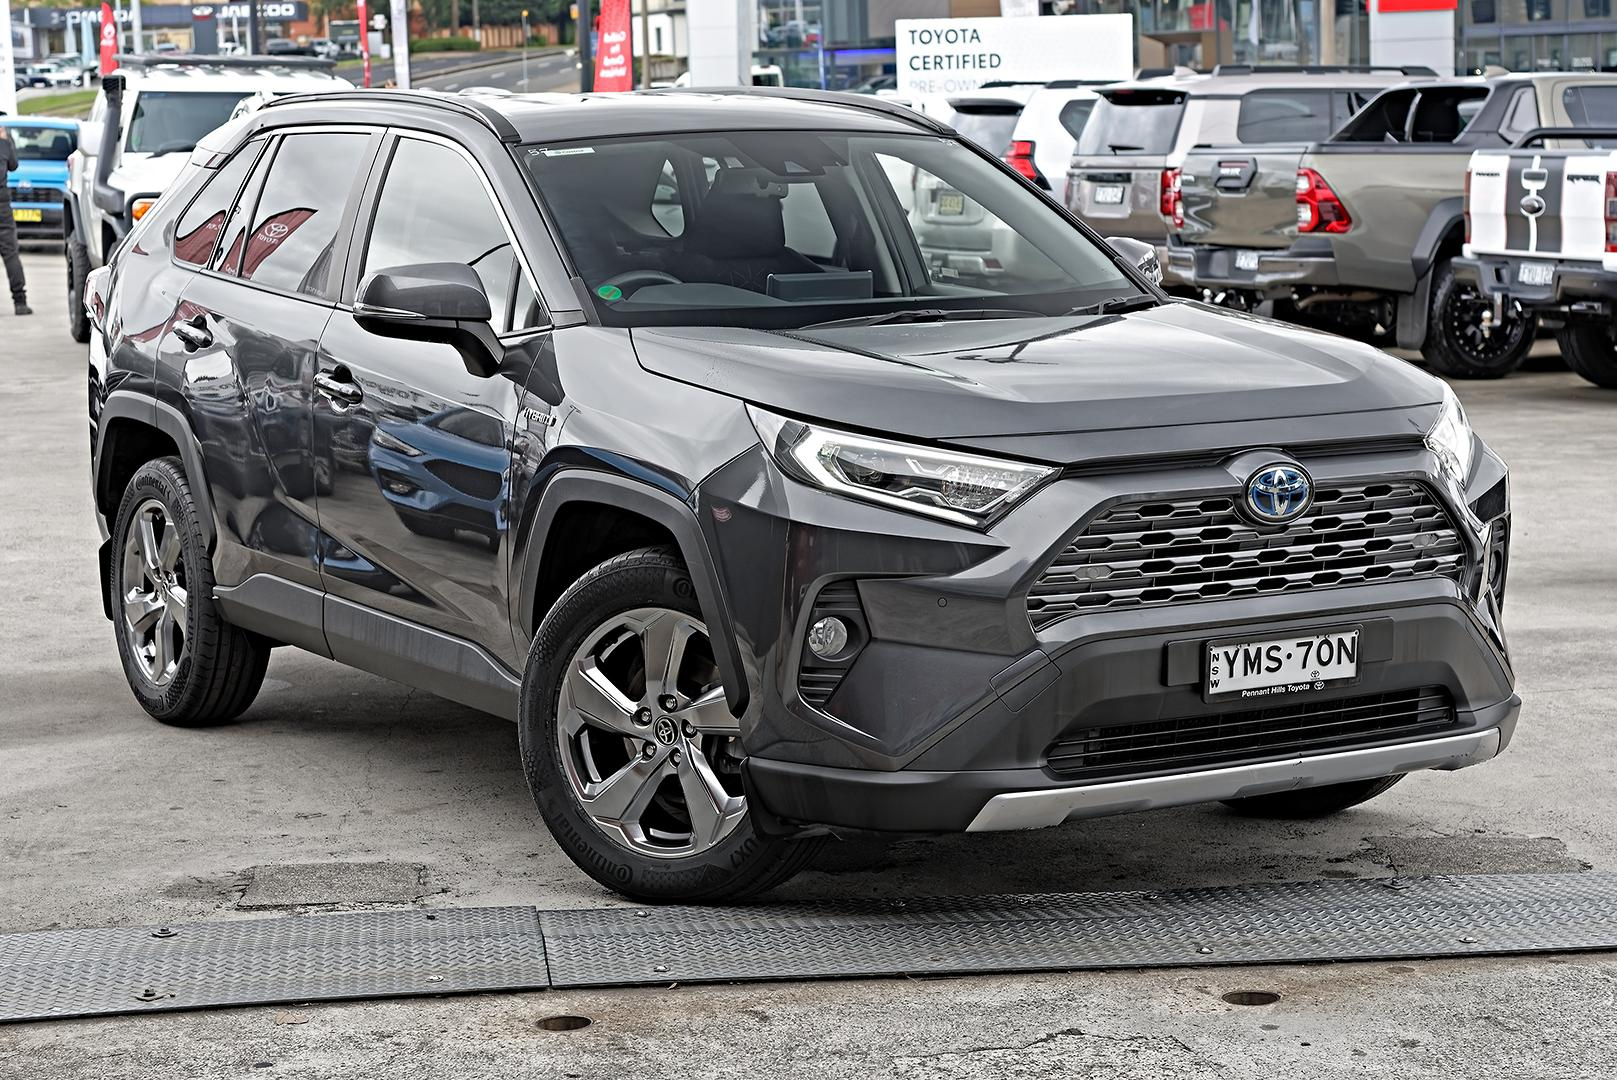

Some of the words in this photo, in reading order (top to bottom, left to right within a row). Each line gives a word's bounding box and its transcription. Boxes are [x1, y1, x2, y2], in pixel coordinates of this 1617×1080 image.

[908, 28, 981, 45] TOYOTA
[909, 53, 1001, 71] CERTIFIED
[909, 79, 1000, 94] PRE-OWN
[1241, 688, 1270, 698] Pennant
[1271, 685, 1286, 695] Hills
[1287, 682, 1310, 692] Toyota
[551, 811, 634, 885] Continental
